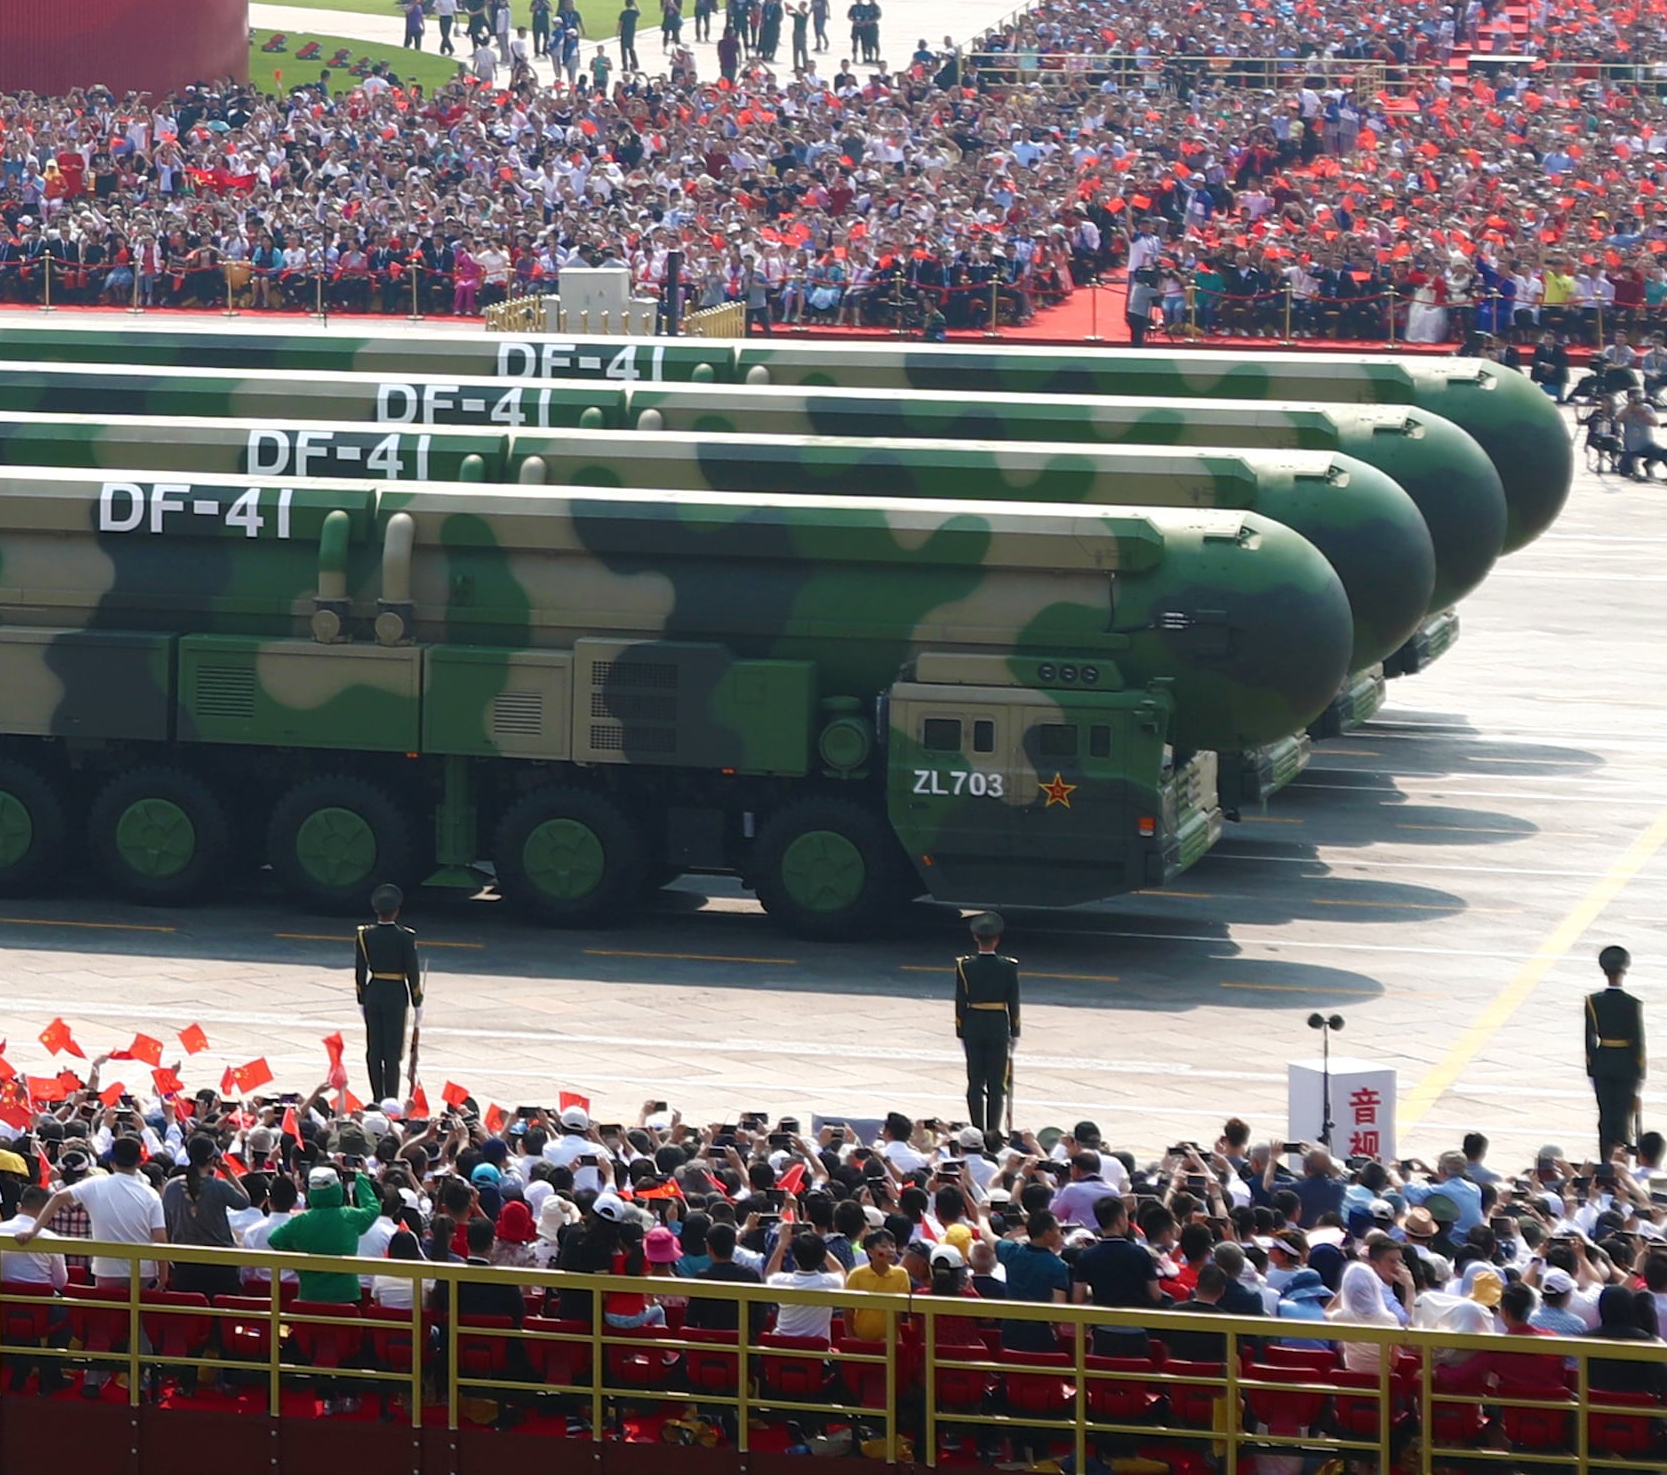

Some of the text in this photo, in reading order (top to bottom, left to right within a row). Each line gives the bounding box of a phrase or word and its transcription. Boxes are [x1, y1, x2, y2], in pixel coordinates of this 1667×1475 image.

[497, 342, 665, 381] DF-41
[377, 384, 552, 427] DF-41
[248, 430, 431, 480] DF-41
[100, 483, 293, 538] DF-41
[913, 770, 1004, 797] ZL703
